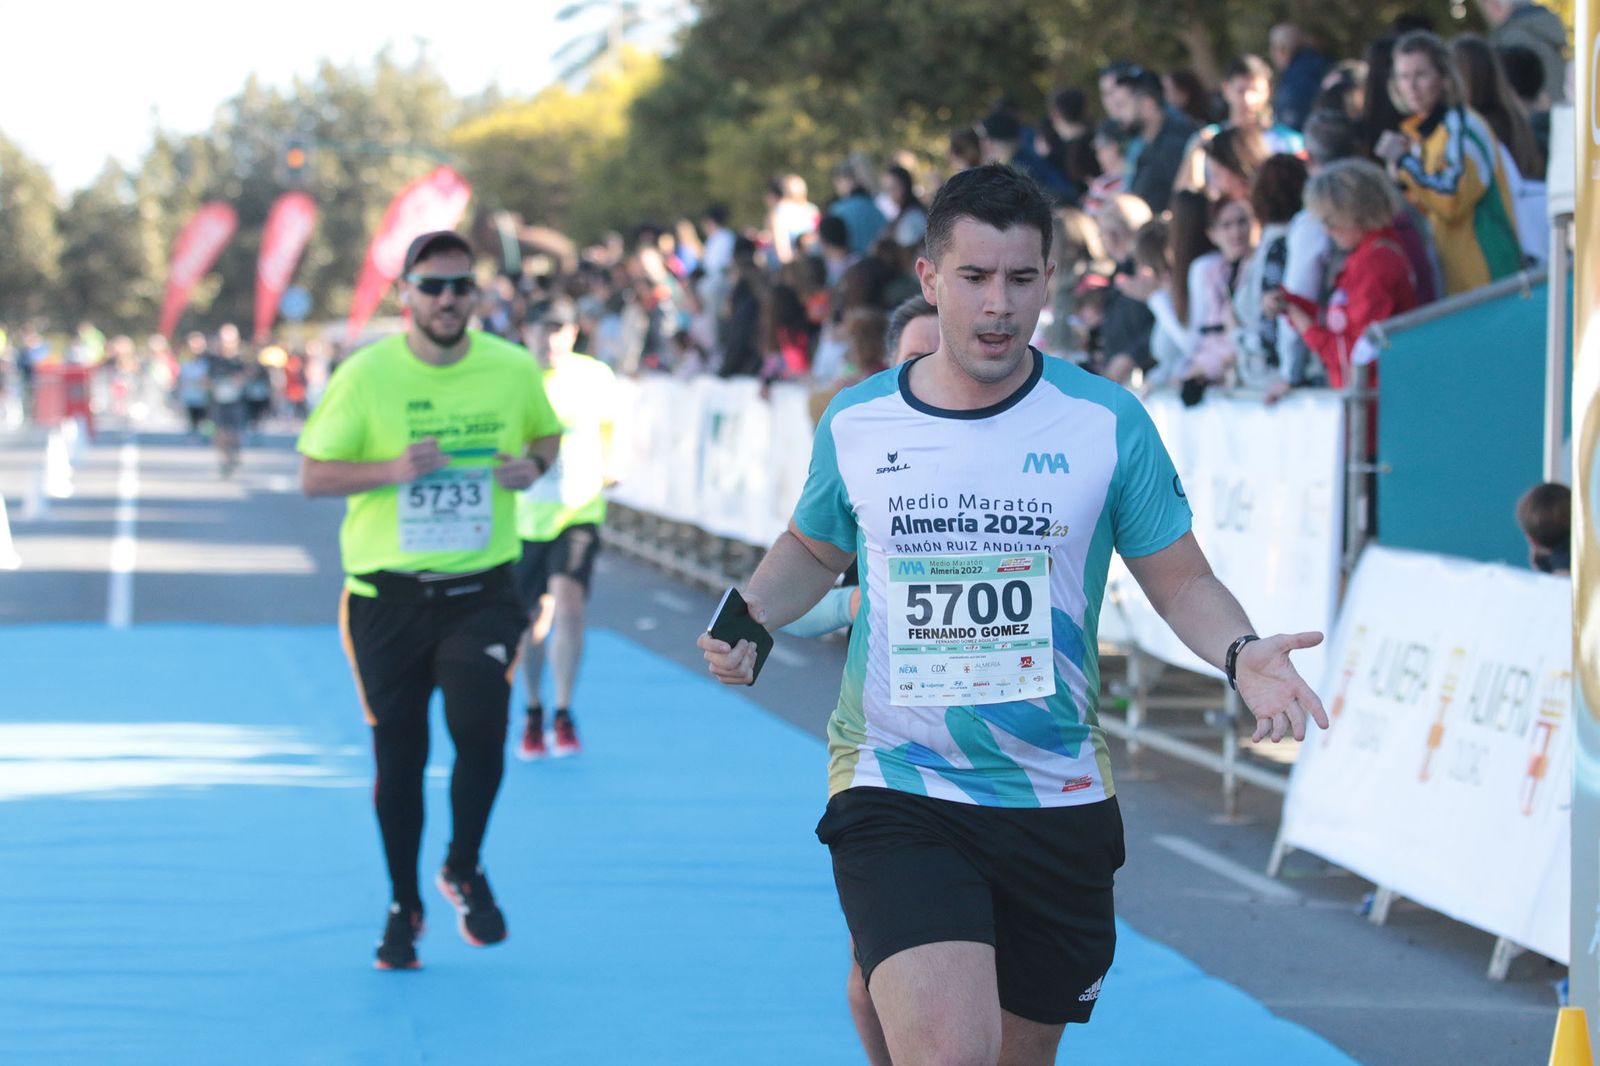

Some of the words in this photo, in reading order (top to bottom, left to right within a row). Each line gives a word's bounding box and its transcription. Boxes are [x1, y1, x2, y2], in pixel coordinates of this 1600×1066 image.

[876, 463, 911, 474] SPALL
[409, 483, 481, 508] 5733
[888, 493, 948, 513] Medio
[958, 494, 1052, 514] Maratón
[891, 512, 978, 536] Almería
[895, 540, 942, 553] RAMÓN
[947, 541, 978, 551] RUIZ
[952, 559, 983, 567] Maratón
[930, 566, 960, 575] Almería
[906, 580, 1032, 626] 5700
[908, 628, 977, 639] FERNANDO
[981, 624, 1030, 637] GOMEZ
[899, 665, 918, 673] NEXA
